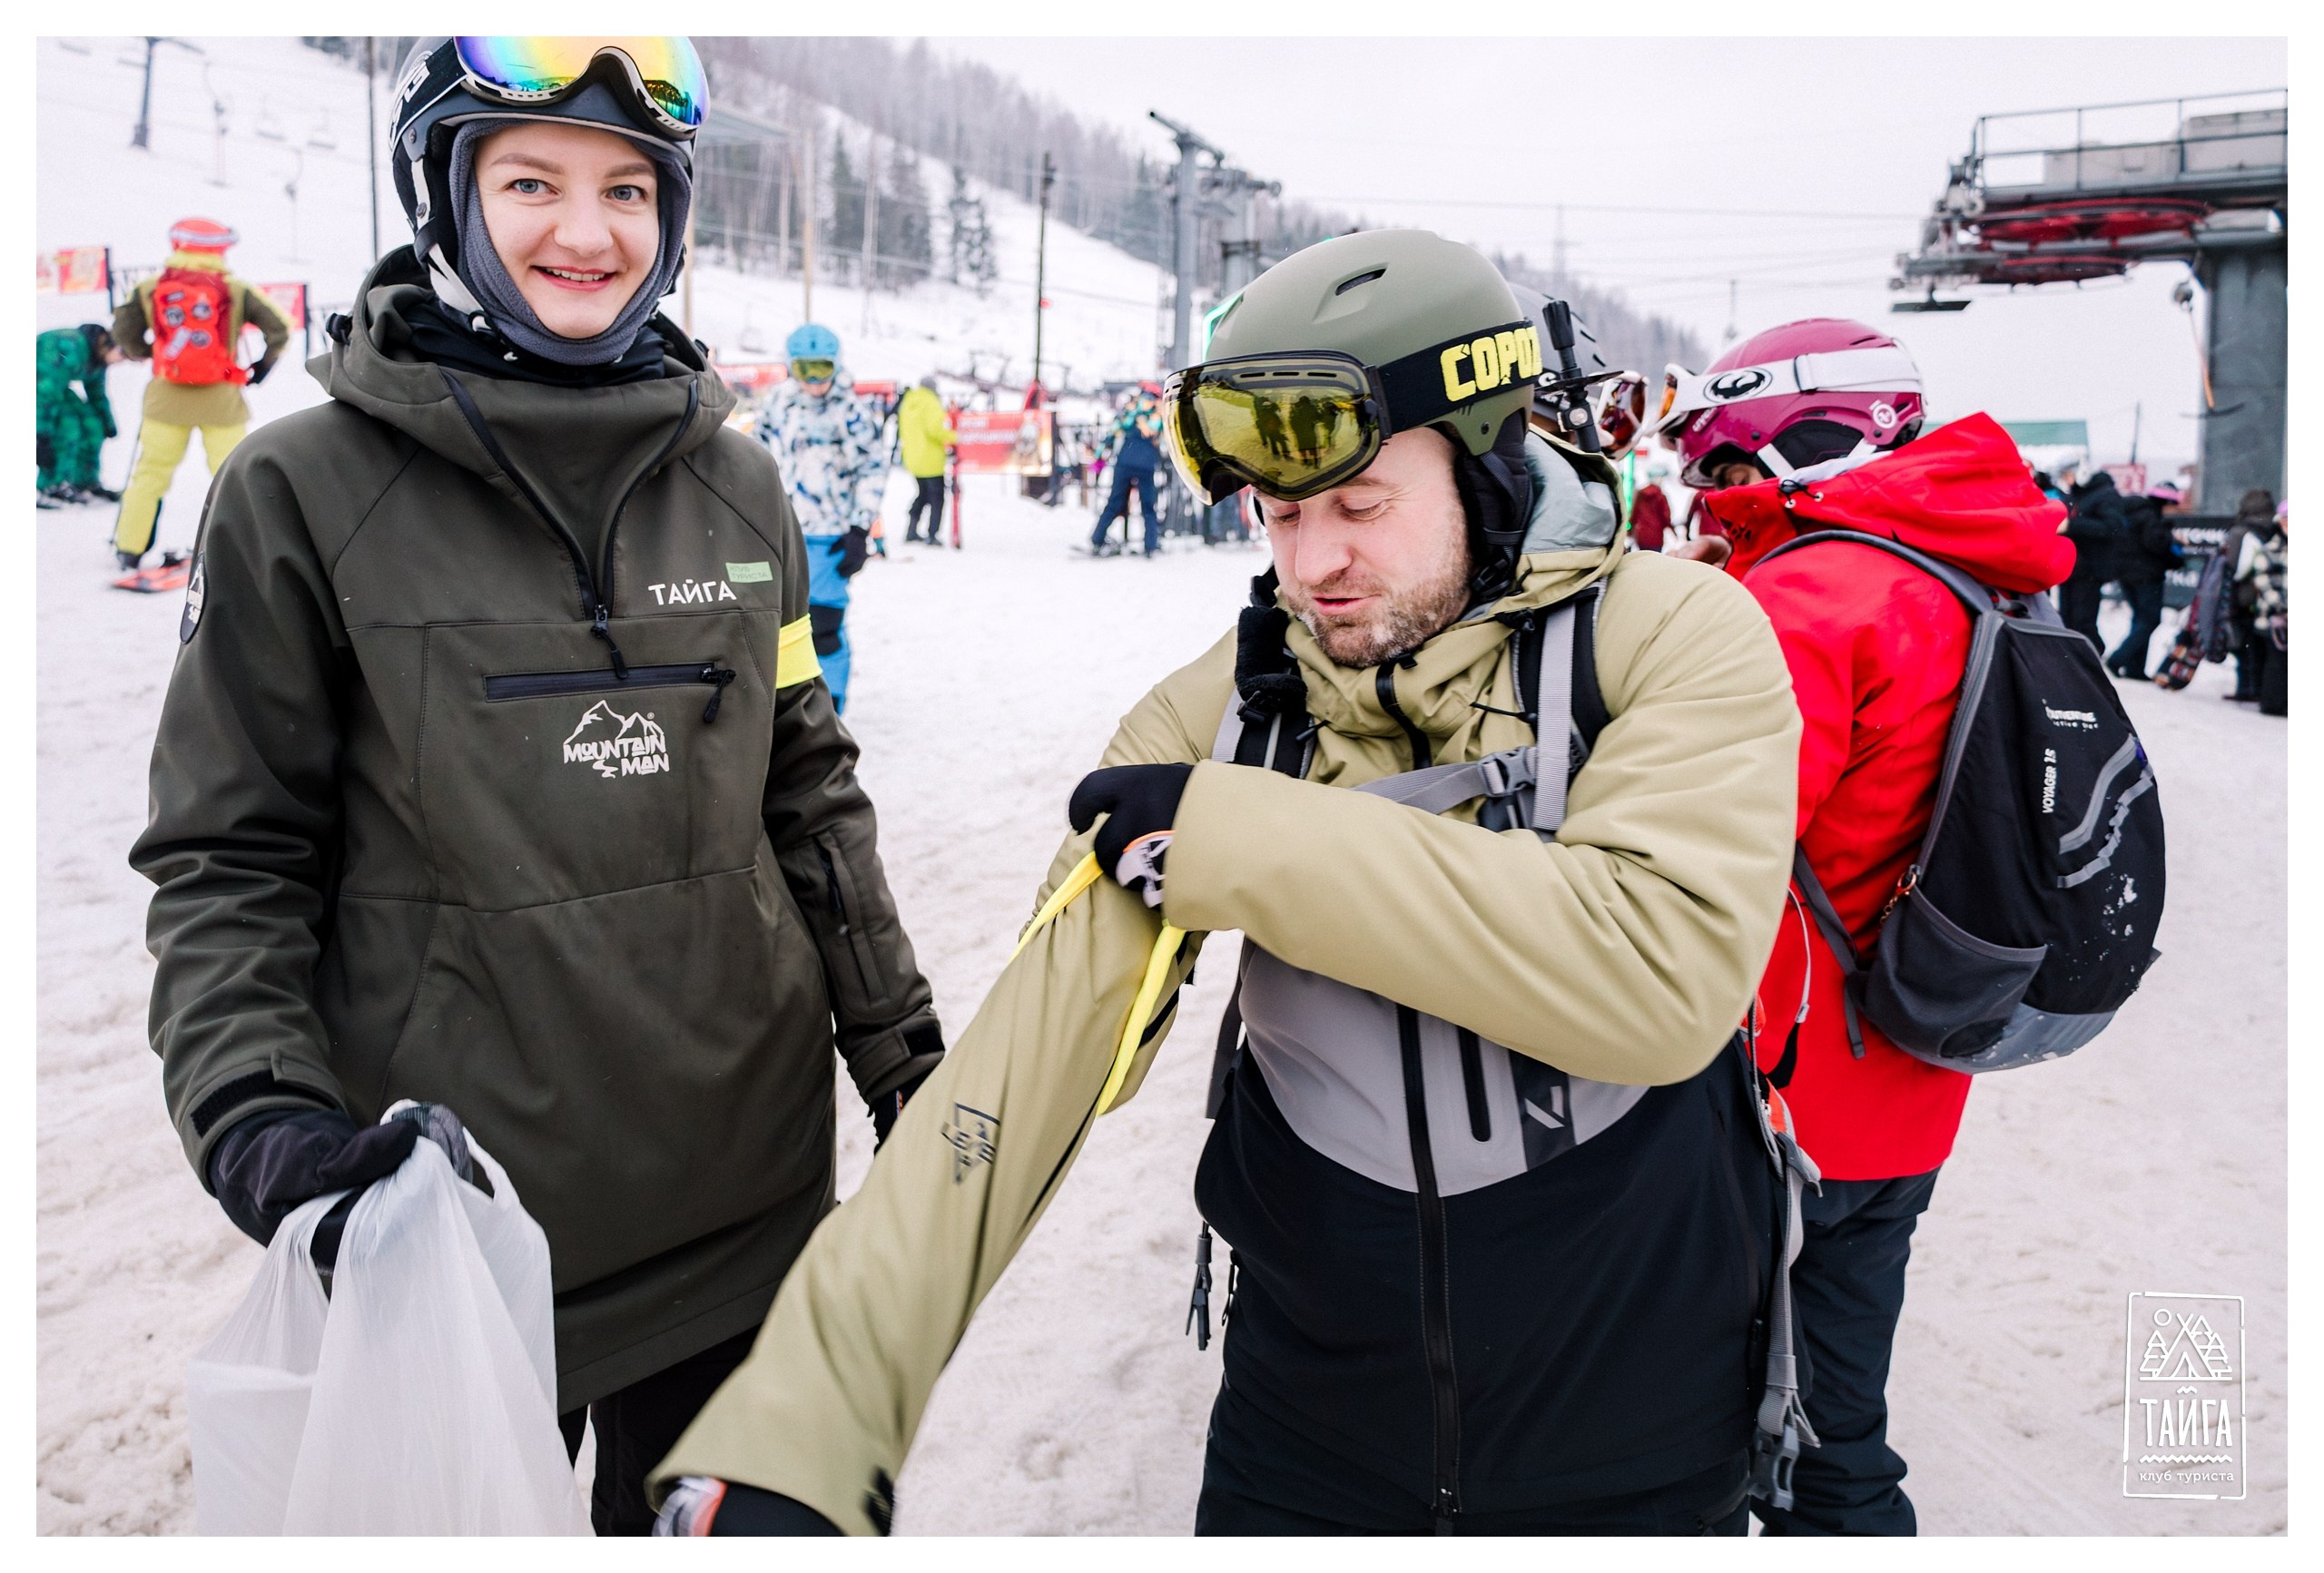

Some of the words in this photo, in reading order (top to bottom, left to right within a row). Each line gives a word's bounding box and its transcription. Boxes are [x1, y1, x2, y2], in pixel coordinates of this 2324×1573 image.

[648, 579, 737, 605] ТАЙГА
[2043, 748, 2057, 763] 15
[2042, 765, 2057, 813] VOYAGER
